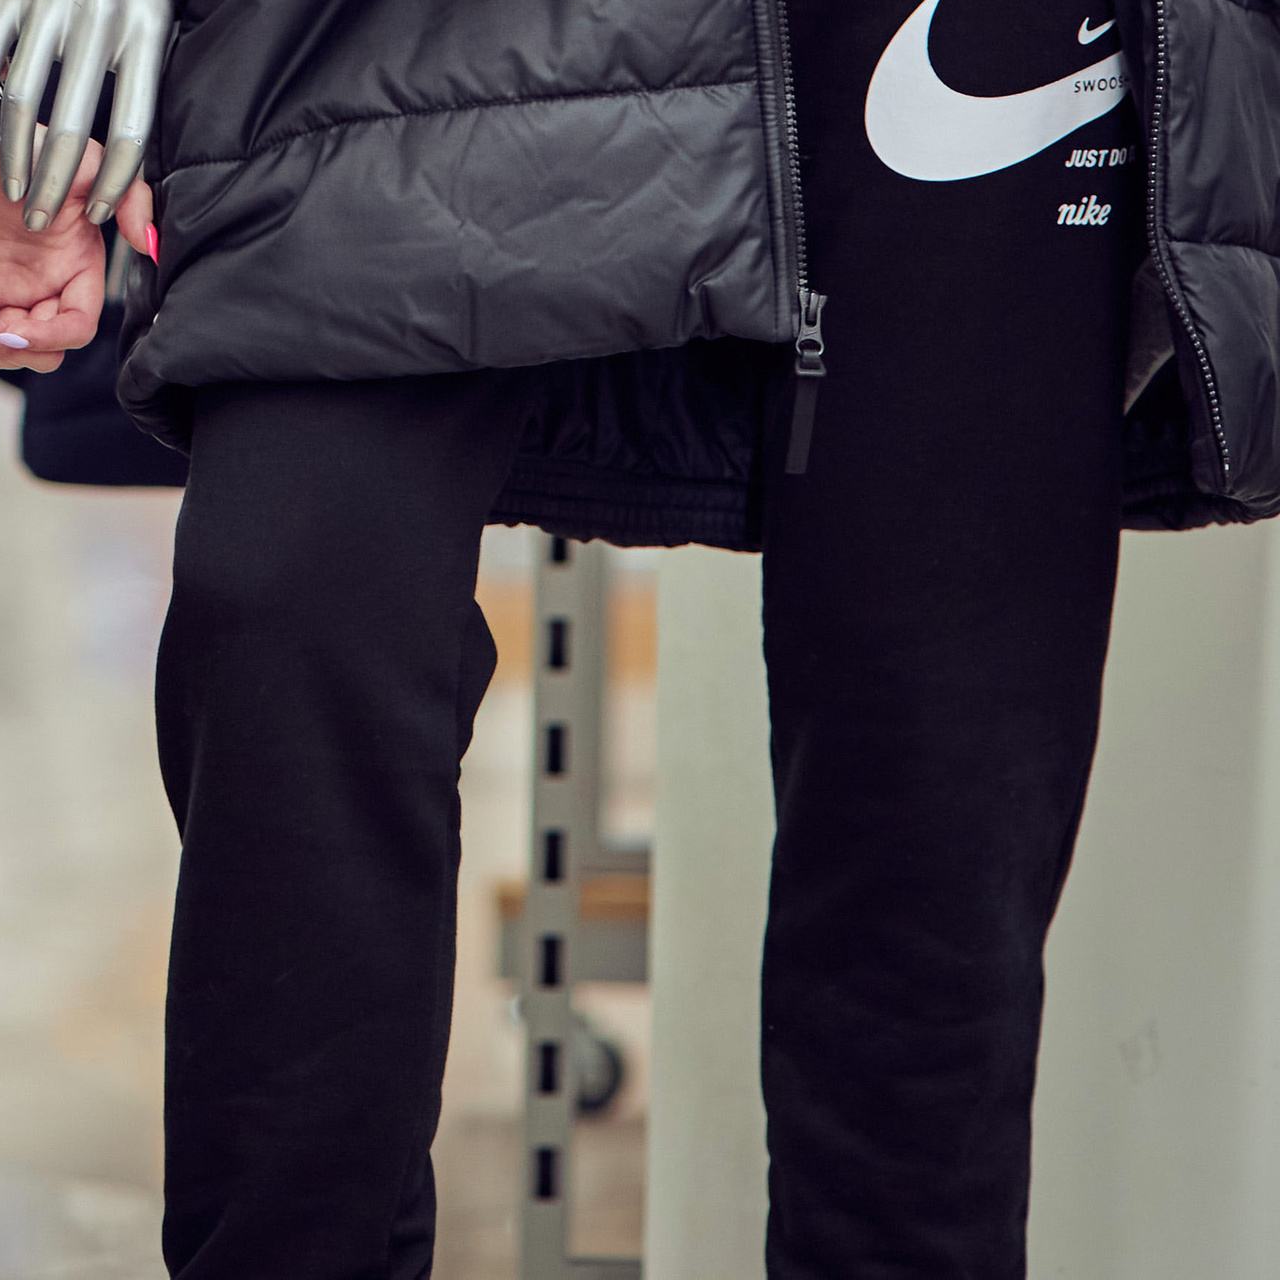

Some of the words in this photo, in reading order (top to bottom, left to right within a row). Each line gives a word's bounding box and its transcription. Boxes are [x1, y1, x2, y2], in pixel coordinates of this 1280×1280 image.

[1074, 75, 1130, 93] SWOOS
[1065, 149, 1109, 168] JUST
[1109, 147, 1127, 167] DO
[1057, 194, 1112, 226] nike
